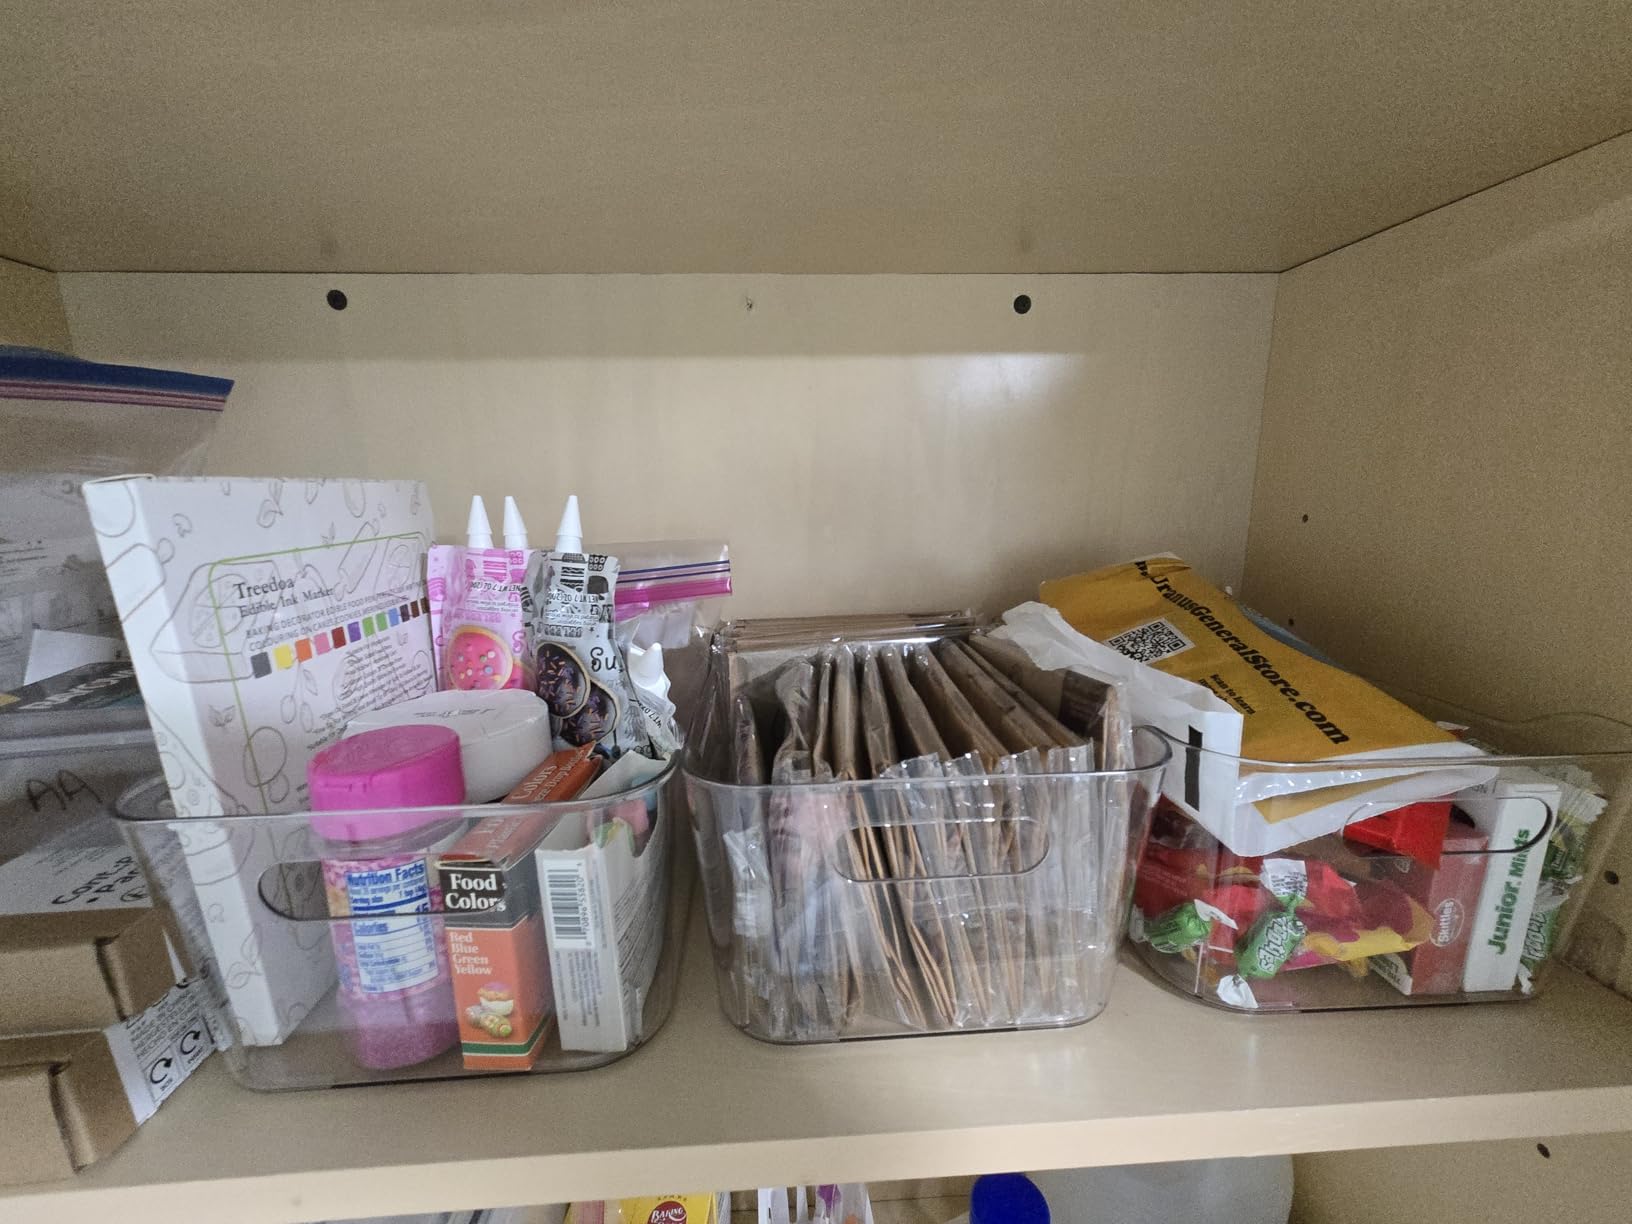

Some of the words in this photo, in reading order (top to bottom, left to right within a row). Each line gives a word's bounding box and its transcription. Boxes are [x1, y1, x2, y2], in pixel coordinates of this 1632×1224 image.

[233, 576, 295, 600] Treedoa
[512, 765, 558, 799] Colors
[395, 863, 425, 880] Facts
[450, 873, 498, 891] Food
[445, 892, 507, 912] Colors
[1436, 900, 1456, 945] Skittles
[1487, 881, 1519, 955] Junior
[450, 931, 473, 943] Red
[451, 943, 480, 954] Blue
[452, 954, 489, 966] Green
[454, 965, 493, 976] Yellow
[651, 1207, 684, 1223] BAKING
